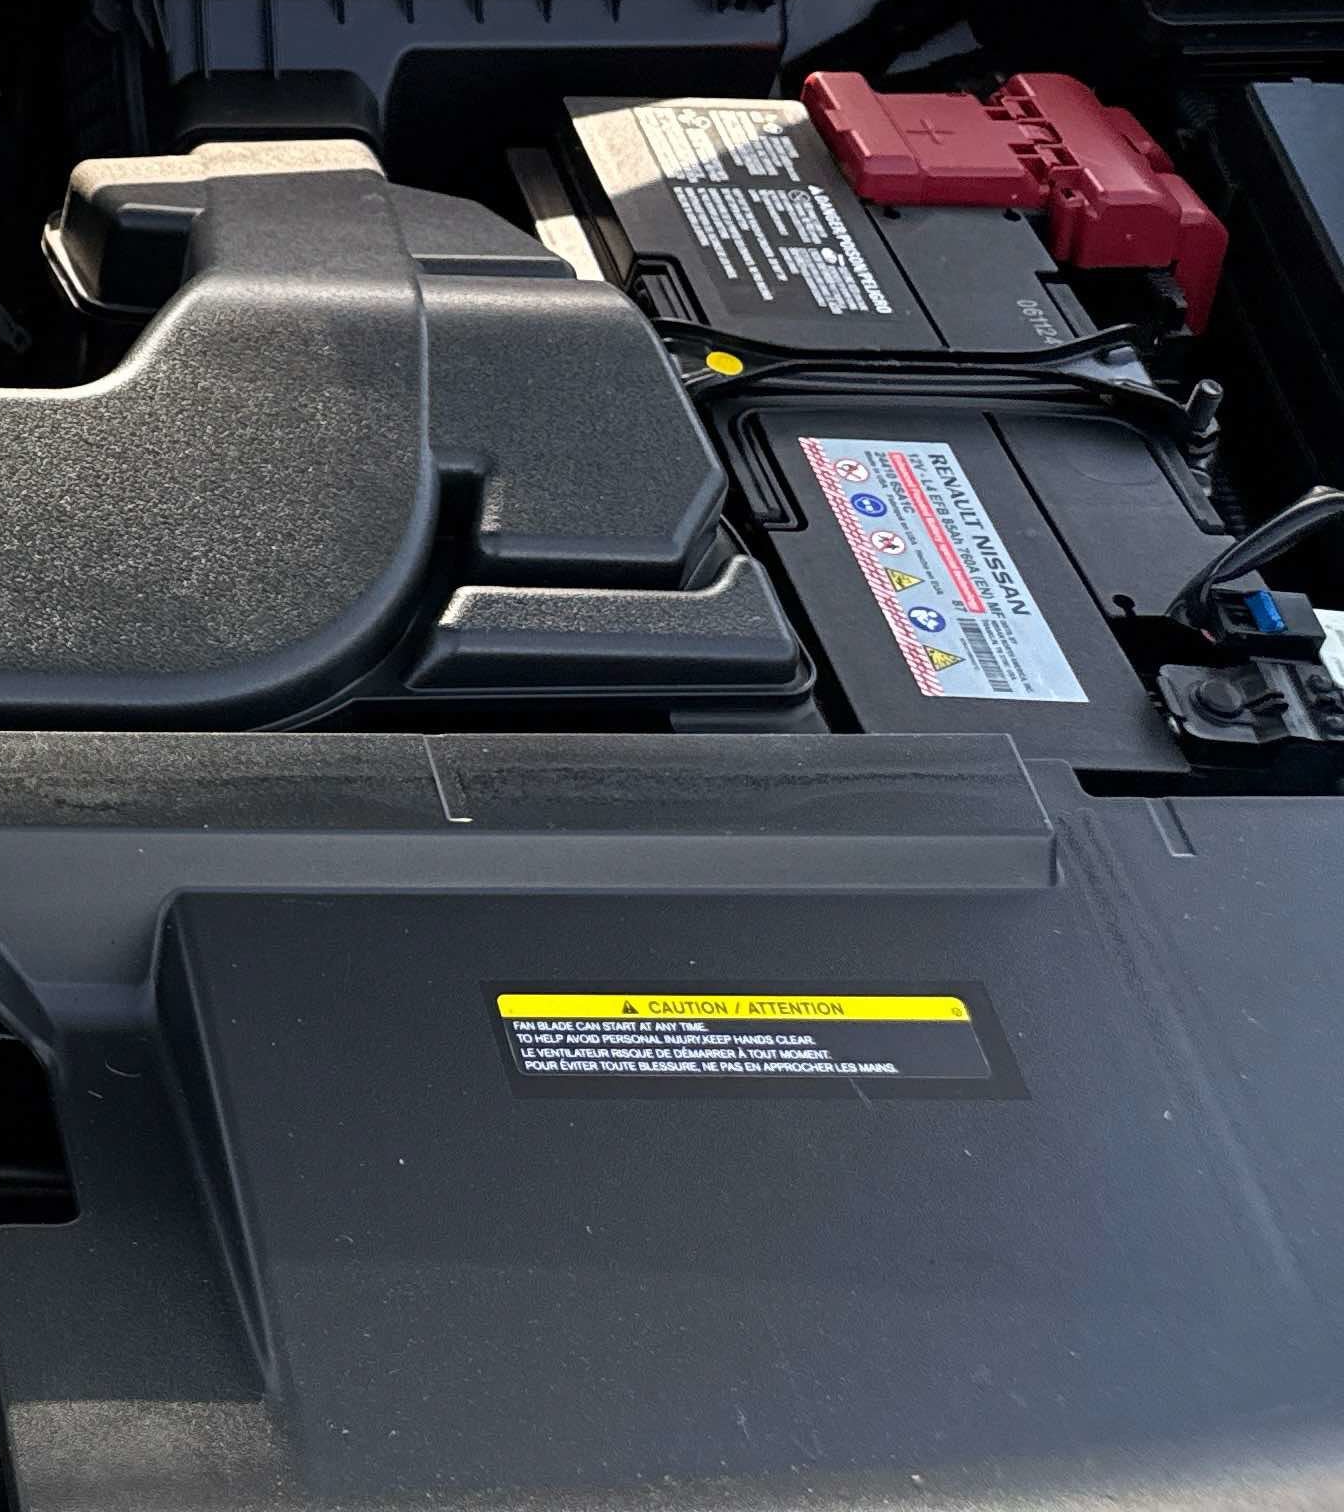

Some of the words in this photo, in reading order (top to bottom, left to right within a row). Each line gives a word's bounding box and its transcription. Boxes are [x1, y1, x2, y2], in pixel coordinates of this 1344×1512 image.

[814, 195, 848, 235] DANGER
[836, 234, 869, 273] POISON
[857, 272, 893, 314] PELIGRO
[906, 453, 926, 471] 12V
[919, 479, 937, 491] L4
[927, 494, 950, 515] EFB
[926, 453, 983, 529] RENAULT
[971, 535, 1030, 615] NISSAN
[940, 518, 966, 544] 85Ah
[955, 547, 981, 573] 760A
[968, 575, 995, 599] (EN)
[648, 1001, 729, 1015] CAUTION
[734, 1002, 740, 1014] /
[748, 1001, 845, 1015] ATTENTION
[513, 1021, 535, 1030] FAN
[537, 1021, 575, 1031] BLADE
[576, 1021, 601, 1031] CAN
[602, 1022, 636, 1031] START
[639, 1022, 653, 1031] AT
[655, 1022, 677, 1031] ANY
[678, 1022, 709, 1031] TIME.
[516, 1034, 533, 1043] TO
[534, 1034, 564, 1043] HELP
[567, 1034, 600, 1044] AVOID
[602, 1034, 663, 1044] PERSONAL
[733, 1035, 775, 1045] HANDS
[776, 1035, 816, 1045] CLEAR.
[520, 1048, 536, 1058] LE
[536, 1048, 610, 1058] VENTILATEUR
[611, 1048, 654, 1059] RISQUE
[655, 1048, 672, 1059] DE
[673, 1046, 736, 1059] DÉMARRER
[737, 1047, 747, 1059] À
[748, 1049, 777, 1059] TOUT
[779, 1050, 833, 1060] MOMENT.
[524, 1061, 558, 1070] POUR
[560, 1058, 598, 1071] ÉVITER
[599, 1061, 637, 1071] TOUTE
[638, 1061, 701, 1072] BLESSURE,
[702, 1062, 718, 1072] NE
[720, 1062, 744, 1072] PAS
[744, 1063, 761, 1073] EN
[763, 1063, 834, 1073] APPROCHER
[835, 1063, 857, 1073] LES
[858, 1063, 899, 1073] MAINS.
